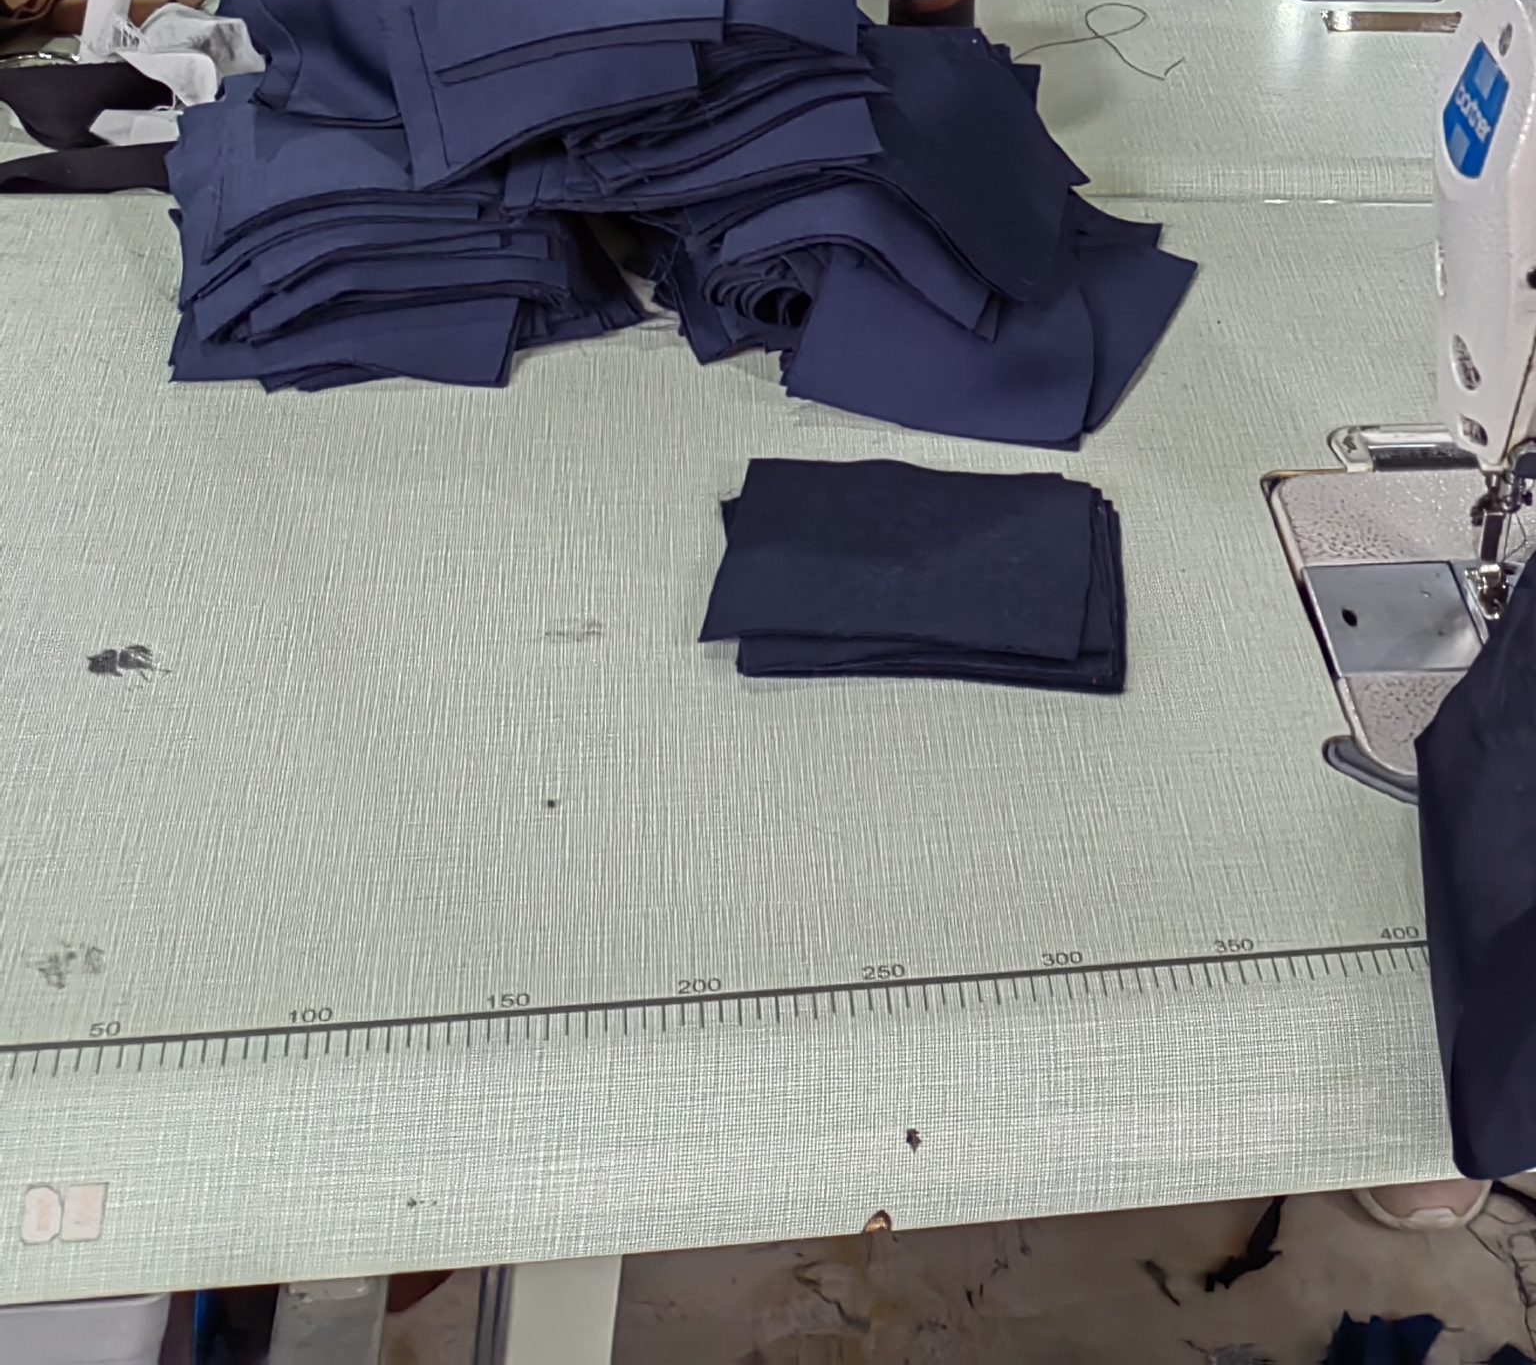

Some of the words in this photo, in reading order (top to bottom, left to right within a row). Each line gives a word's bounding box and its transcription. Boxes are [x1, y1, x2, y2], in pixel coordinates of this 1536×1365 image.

[89, 1022, 121, 1037] 50
[289, 1007, 333, 1024] 100
[487, 993, 531, 1009] 150
[678, 978, 722, 994] 200
[862, 964, 906, 980] 250
[1042, 951, 1083, 967] 300
[1214, 938, 1254, 953] 350
[1380, 926, 1419, 940] 400
